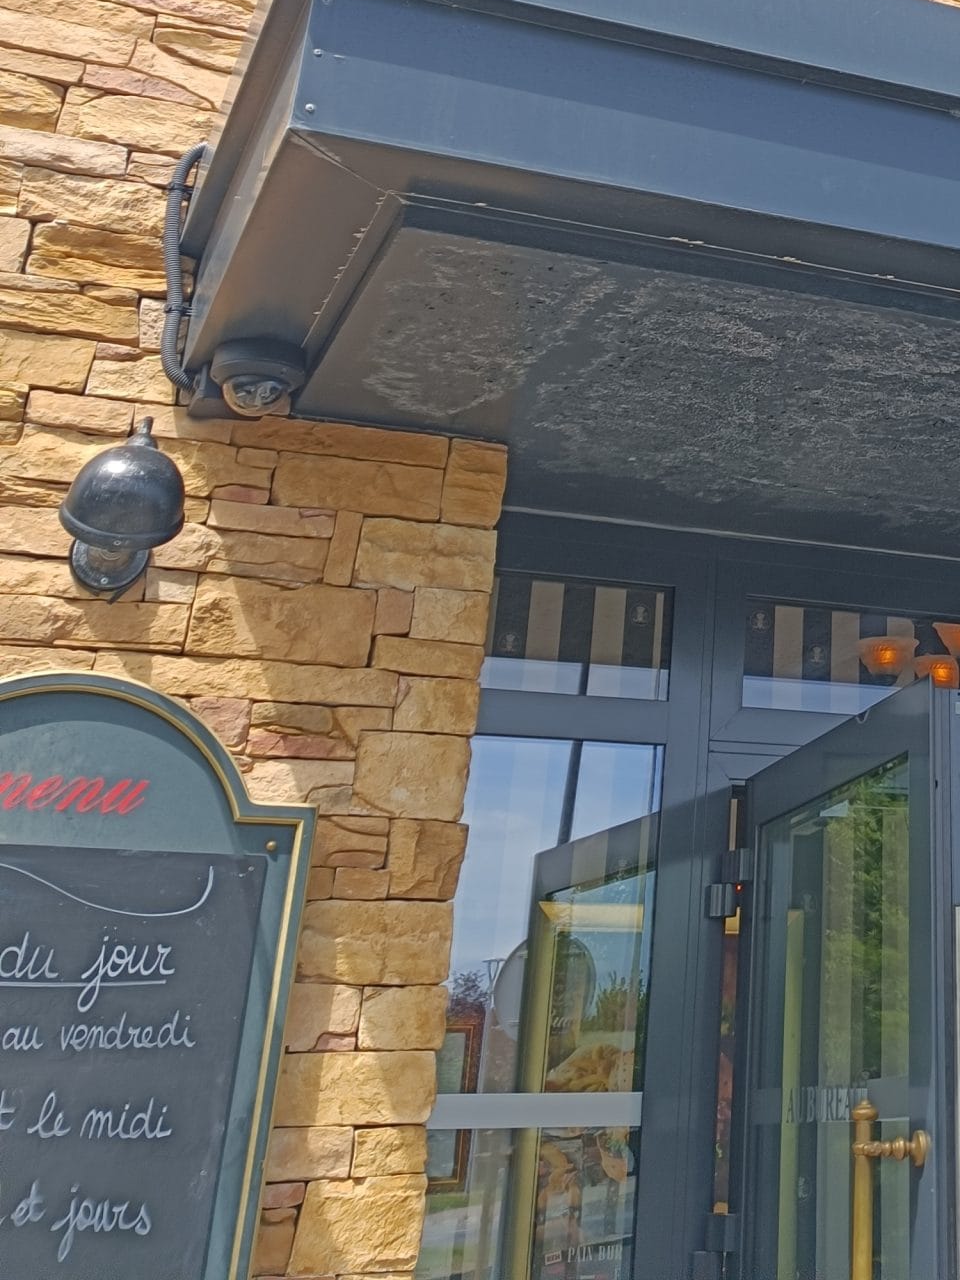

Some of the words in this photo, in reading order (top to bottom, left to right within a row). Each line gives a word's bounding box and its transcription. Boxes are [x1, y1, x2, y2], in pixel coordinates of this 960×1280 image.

[0, 931, 59, 980] du
[77, 935, 175, 1013] jour
[2, 1025, 44, 1051] au
[60, 1009, 196, 1052] vendredi
[27, 1090, 71, 1138] le
[80, 1097, 172, 1139] midi
[11, 1178, 47, 1227] et
[51, 1182, 152, 1263] jours
